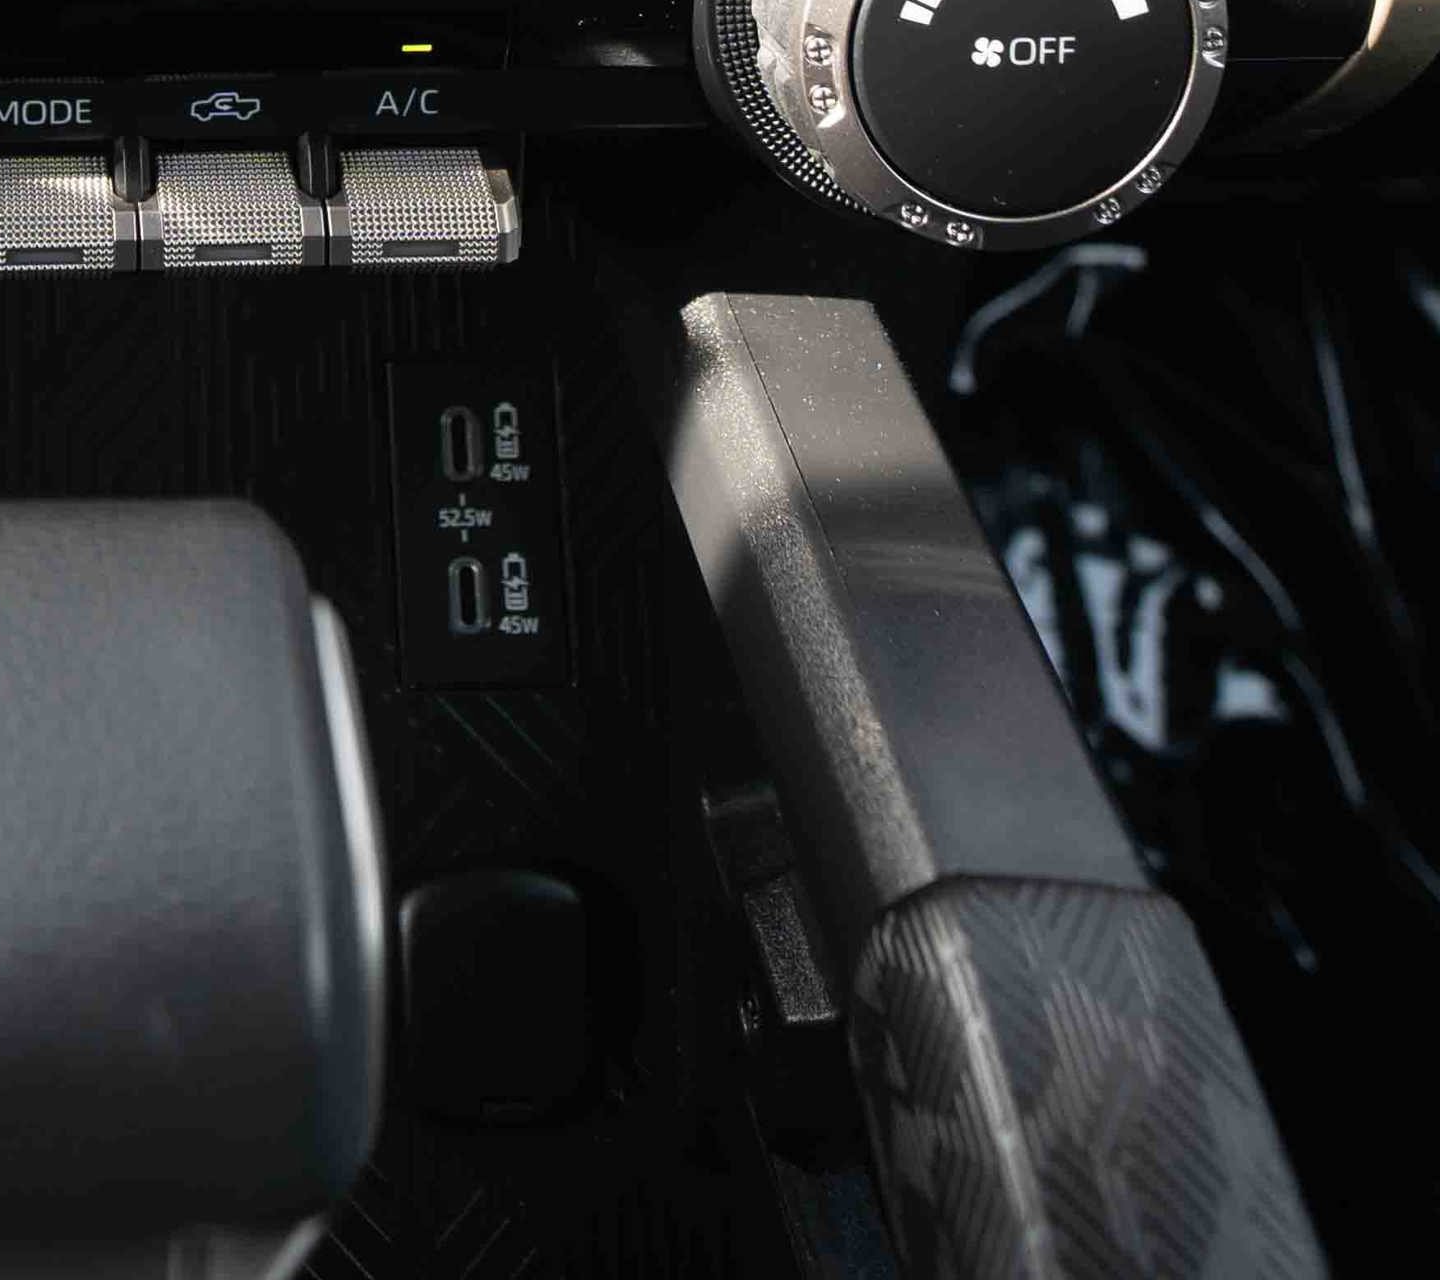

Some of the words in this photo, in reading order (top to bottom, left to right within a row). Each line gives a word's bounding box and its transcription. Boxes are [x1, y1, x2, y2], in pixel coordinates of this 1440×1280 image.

[1009, 36, 1077, 66] OFF
[375, 87, 440, 117] A/C
[490, 463, 530, 482] 45W
[439, 508, 493, 528] 52.5W
[499, 615, 539, 634] 45W
